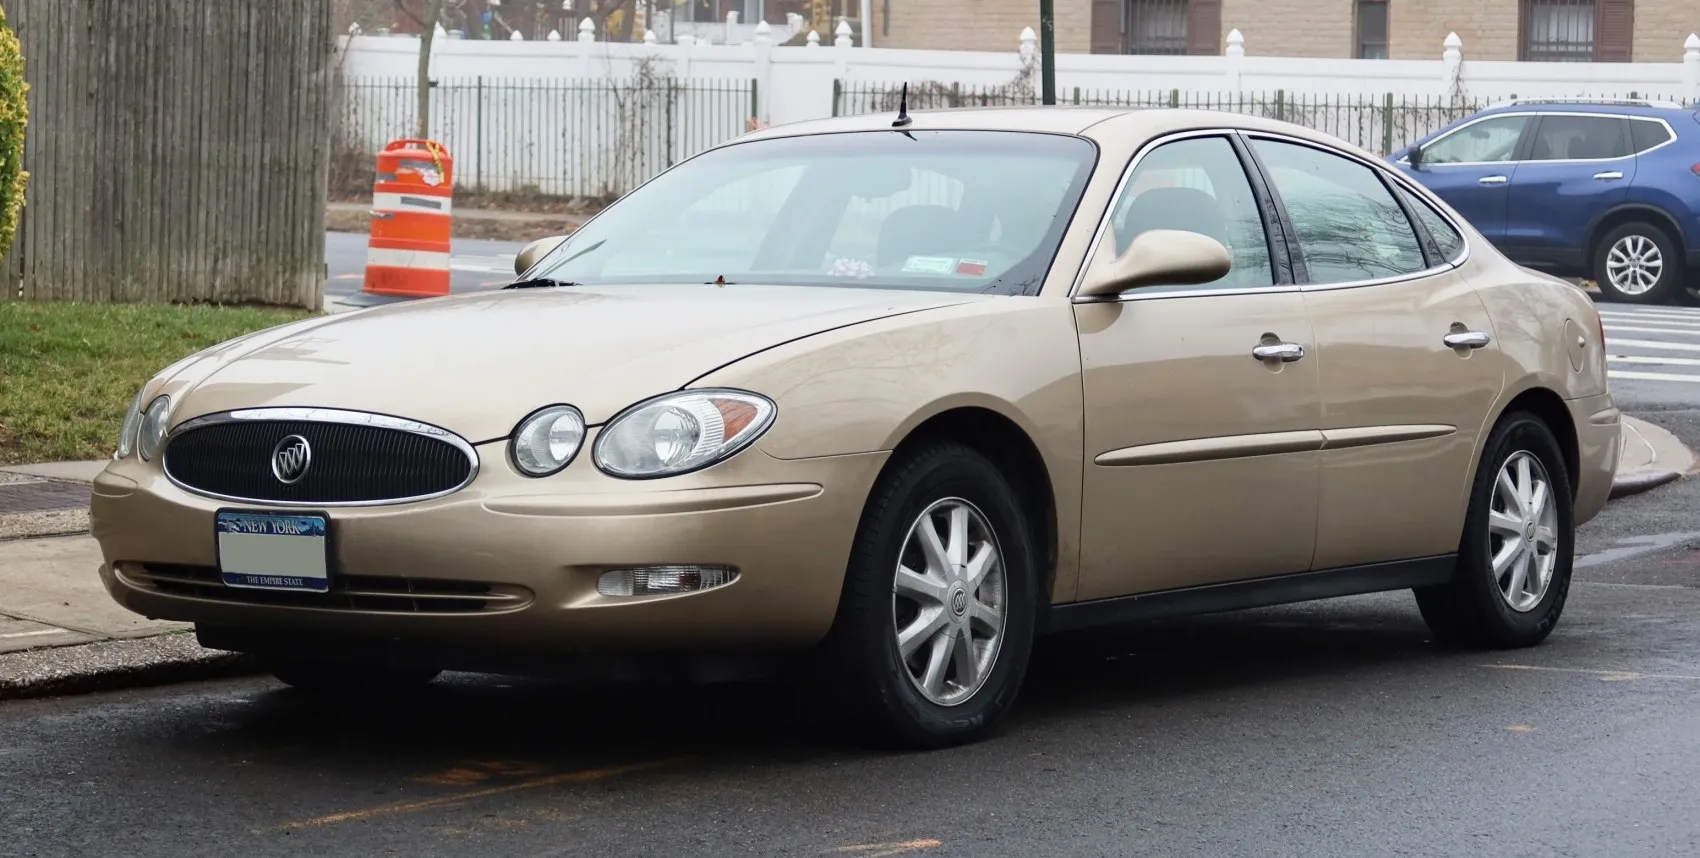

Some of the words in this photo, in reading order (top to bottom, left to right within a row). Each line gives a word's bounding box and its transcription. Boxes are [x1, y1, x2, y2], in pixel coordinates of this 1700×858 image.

[243, 519, 267, 533] NEW
[271, 520, 300, 535] YORK
[246, 576, 259, 584] THE
[260, 576, 283, 585] EMPIRE
[284, 578, 304, 586] STATE
